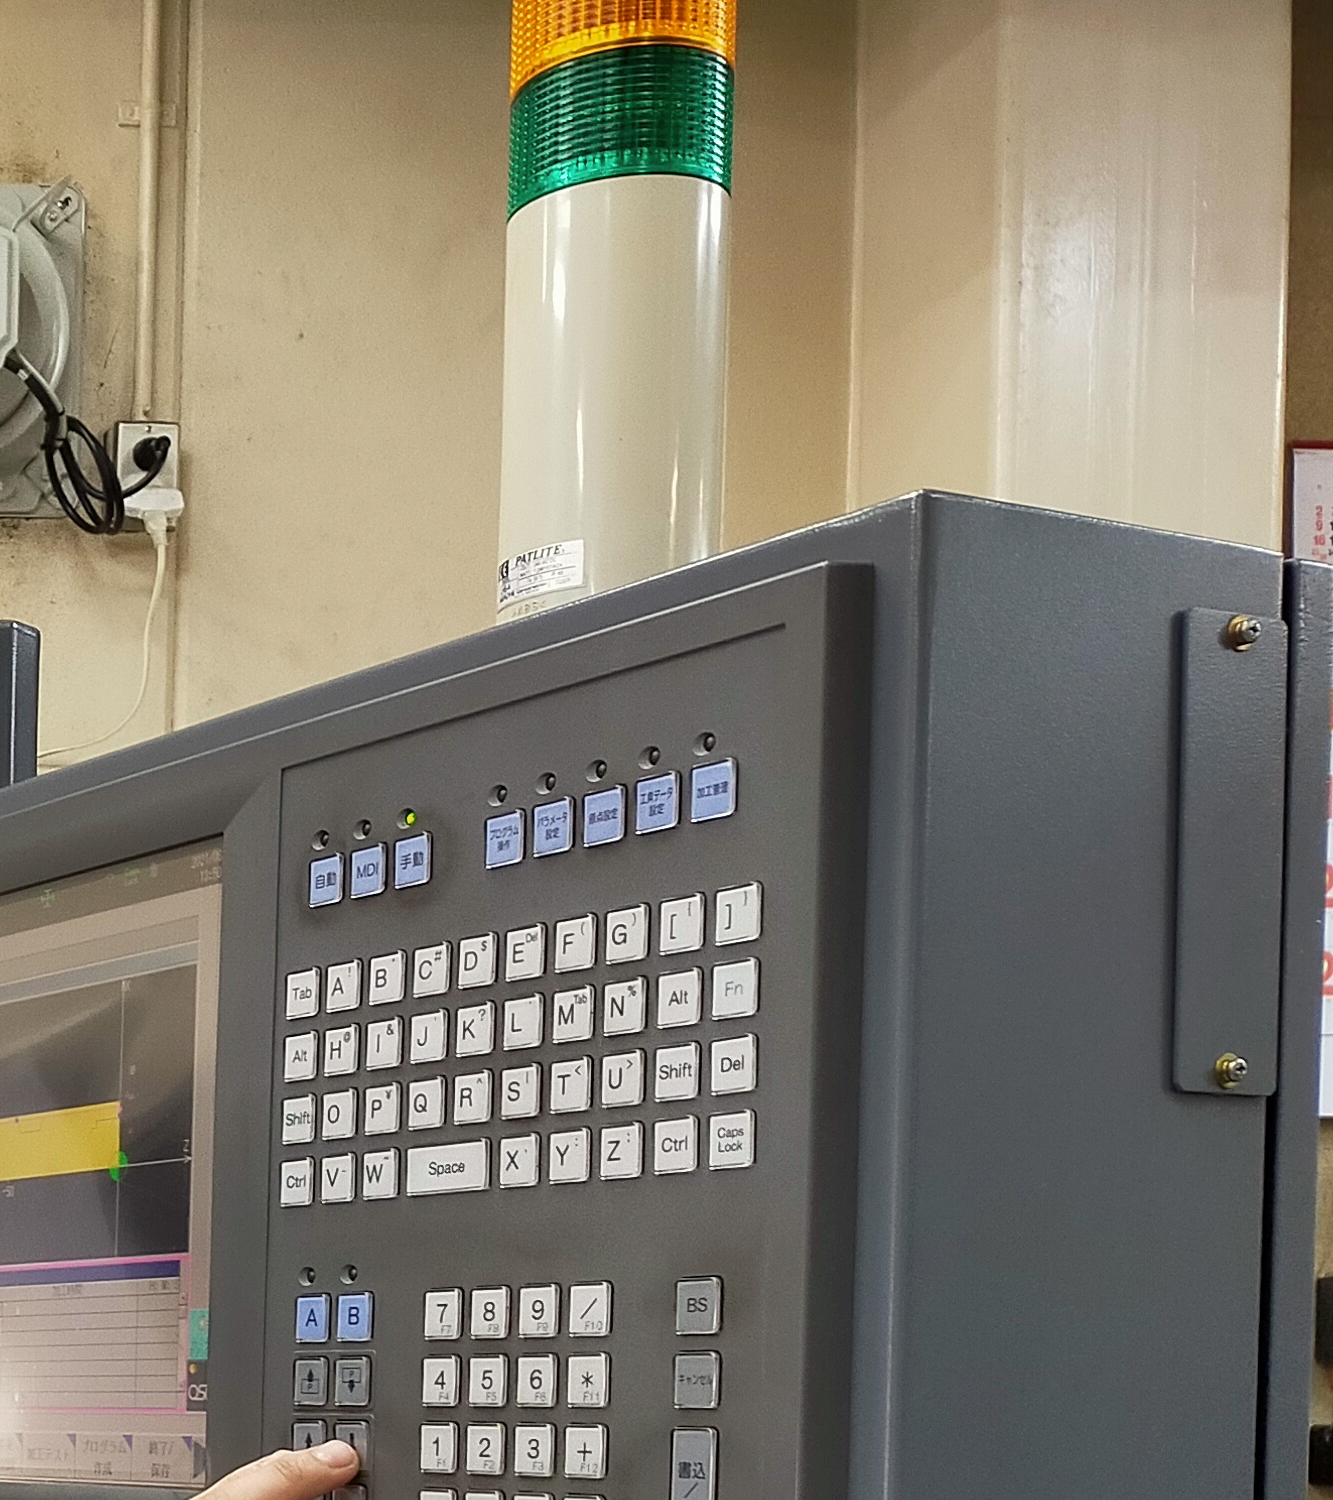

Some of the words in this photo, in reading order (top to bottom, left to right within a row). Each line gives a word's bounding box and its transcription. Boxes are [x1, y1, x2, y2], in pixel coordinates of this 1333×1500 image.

[515, 545, 562, 567] PATLITE
[649, 803, 665, 816] 設定
[490, 827, 519, 841] プログラム
[545, 827, 560, 840] 設定
[401, 851, 424, 870] 手動
[356, 862, 380, 879] MDI
[315, 873, 336, 890] 自動
[563, 933, 575, 954] F
[612, 924, 627, 945] G
[464, 951, 478, 971] D
[513, 942, 524, 963] E
[375, 969, 387, 988] B
[419, 960, 432, 980] C
[292, 987, 312, 1000] Tab
[331, 977, 343, 996] A
[725, 981, 742, 996] Fn
[611, 996, 624, 1018] N
[669, 990, 688, 1006] Alt
[511, 1013, 522, 1032] L
[558, 1004, 574, 1026] M
[417, 1027, 427, 1046] J
[463, 1019, 475, 1040] K
[292, 1050, 307, 1062] Alt
[330, 1040, 341, 1060] H
[659, 1063, 692, 1080] Shift
[721, 1055, 744, 1072] Del
[557, 1074, 571, 1095] T
[609, 1067, 622, 1089] U
[460, 1088, 472, 1108] R
[508, 1081, 520, 1101] S
[371, 1100, 382, 1118] P
[414, 1094, 427, 1113] Q
[286, 1111, 312, 1128] Shift
[328, 1105, 340, 1124] O
[662, 1135, 687, 1152] Ctrl
[718, 1127, 744, 1142] Caps
[718, 1136, 742, 1152] Lock
[556, 1145, 569, 1166] Y
[607, 1140, 621, 1161] Z
[429, 1162, 465, 1177] Space
[506, 1150, 519, 1171] X
[287, 1175, 306, 1188] Ctrl
[326, 1168, 339, 1187] V
[366, 1164, 383, 1183] W
[437, 1304, 448, 1323] 7
[483, 1302, 495, 1321] 8
[532, 1300, 544, 1320] 9
[687, 1298, 707, 1312] BS
[306, 1309, 317, 1326] A
[348, 1307, 359, 1325] B
[434, 1371, 446, 1390] 4
[481, 1370, 492, 1389] 5
[530, 1369, 542, 1389] 6
[433, 1437, 439, 1456] 1
[479, 1438, 490, 1457] 2
[527, 1439, 539, 1459] 3
[677, 1461, 706, 1481] 書込
